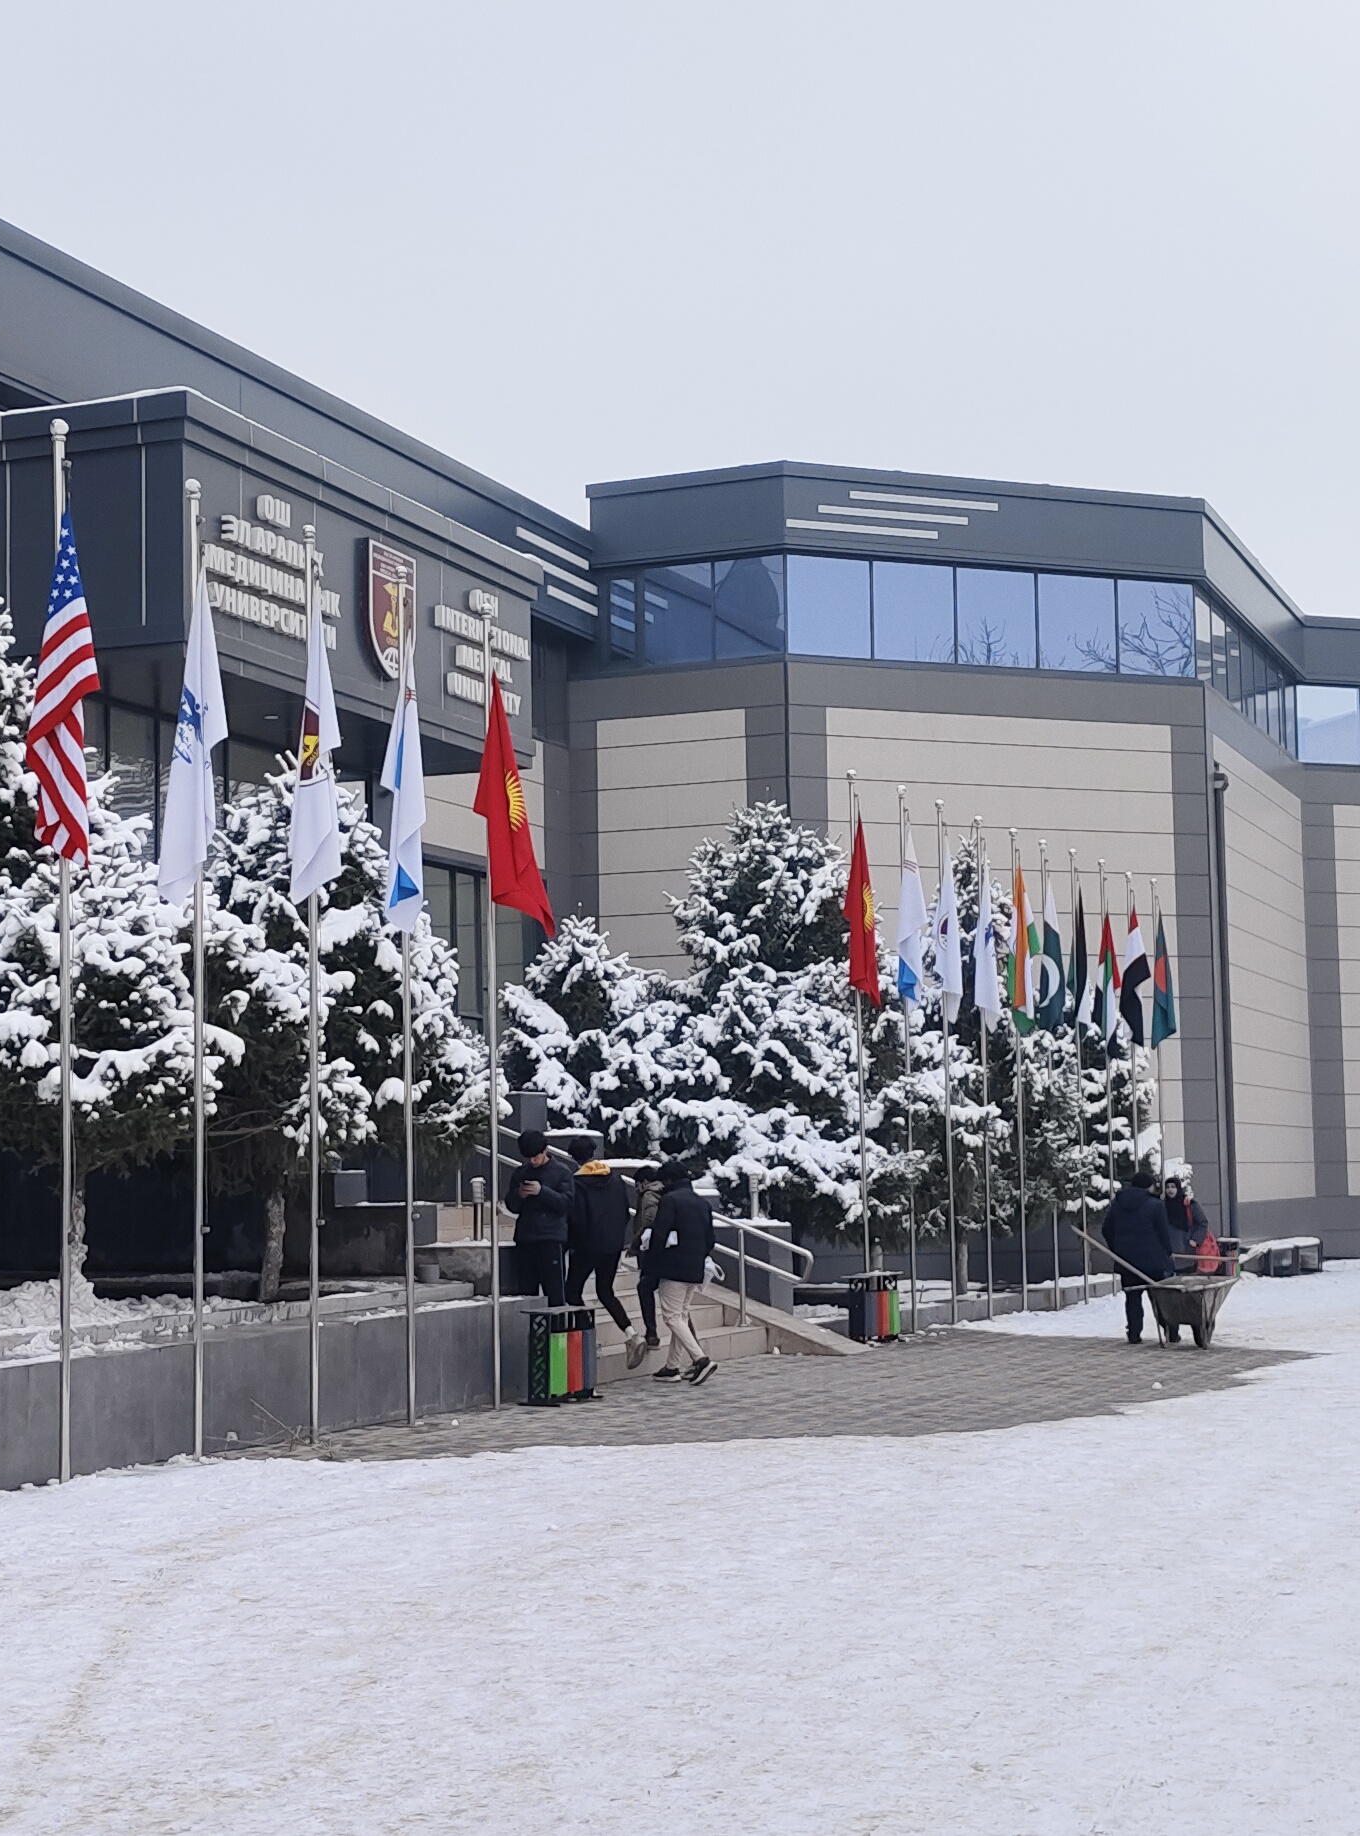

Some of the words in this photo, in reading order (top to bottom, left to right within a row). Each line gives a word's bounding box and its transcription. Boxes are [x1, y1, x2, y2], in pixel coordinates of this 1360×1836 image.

[220, 514, 252, 548] ЭЛ
[256, 494, 291, 529] ОШ
[203, 543, 341, 619] МЕДИЦИНАЫК
[206, 581, 337, 651] УНИВЕРСИТИ
[434, 604, 531, 662] INTERNTIONAL
[455, 644, 513, 684] MECAL
[446, 671, 521, 716] UNIVITY
